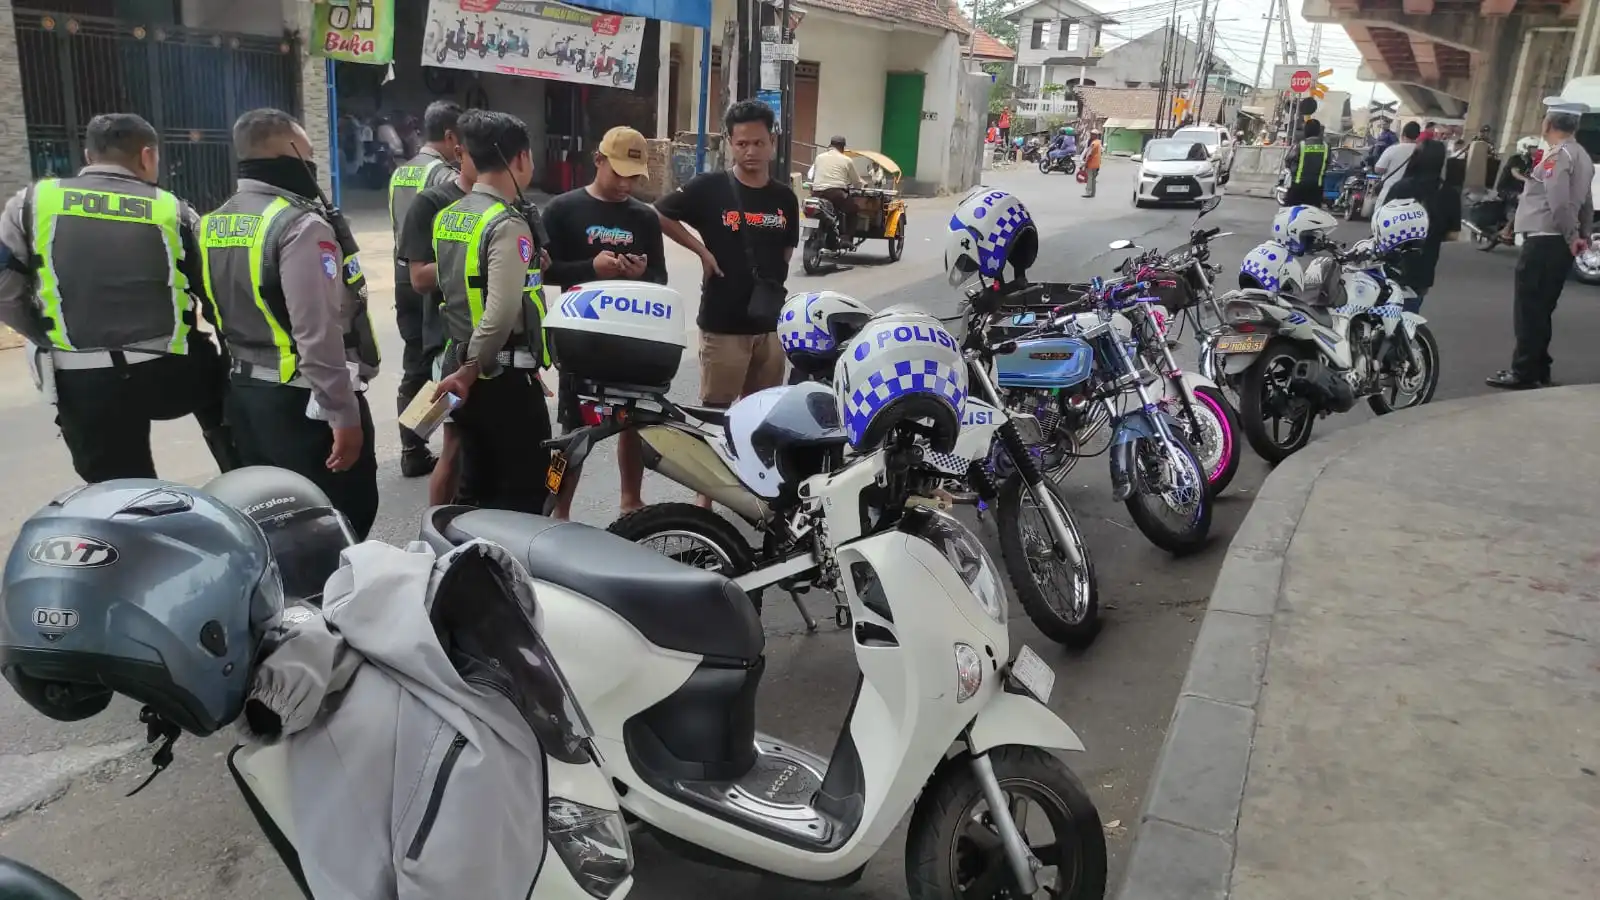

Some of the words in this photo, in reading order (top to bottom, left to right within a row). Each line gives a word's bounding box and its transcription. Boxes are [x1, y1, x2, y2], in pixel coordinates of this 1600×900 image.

[329, 5, 374, 30] OM
[324, 31, 375, 56] Buka
[1291, 77, 1312, 87] STOP
[63, 190, 153, 221] POLISI
[206, 215, 261, 239] POLISI
[439, 211, 481, 235] POLISI
[600, 295, 672, 319] POLISI
[877, 324, 957, 353] POLISI
[31, 541, 110, 563] KYT
[37, 611, 73, 626] DOT
